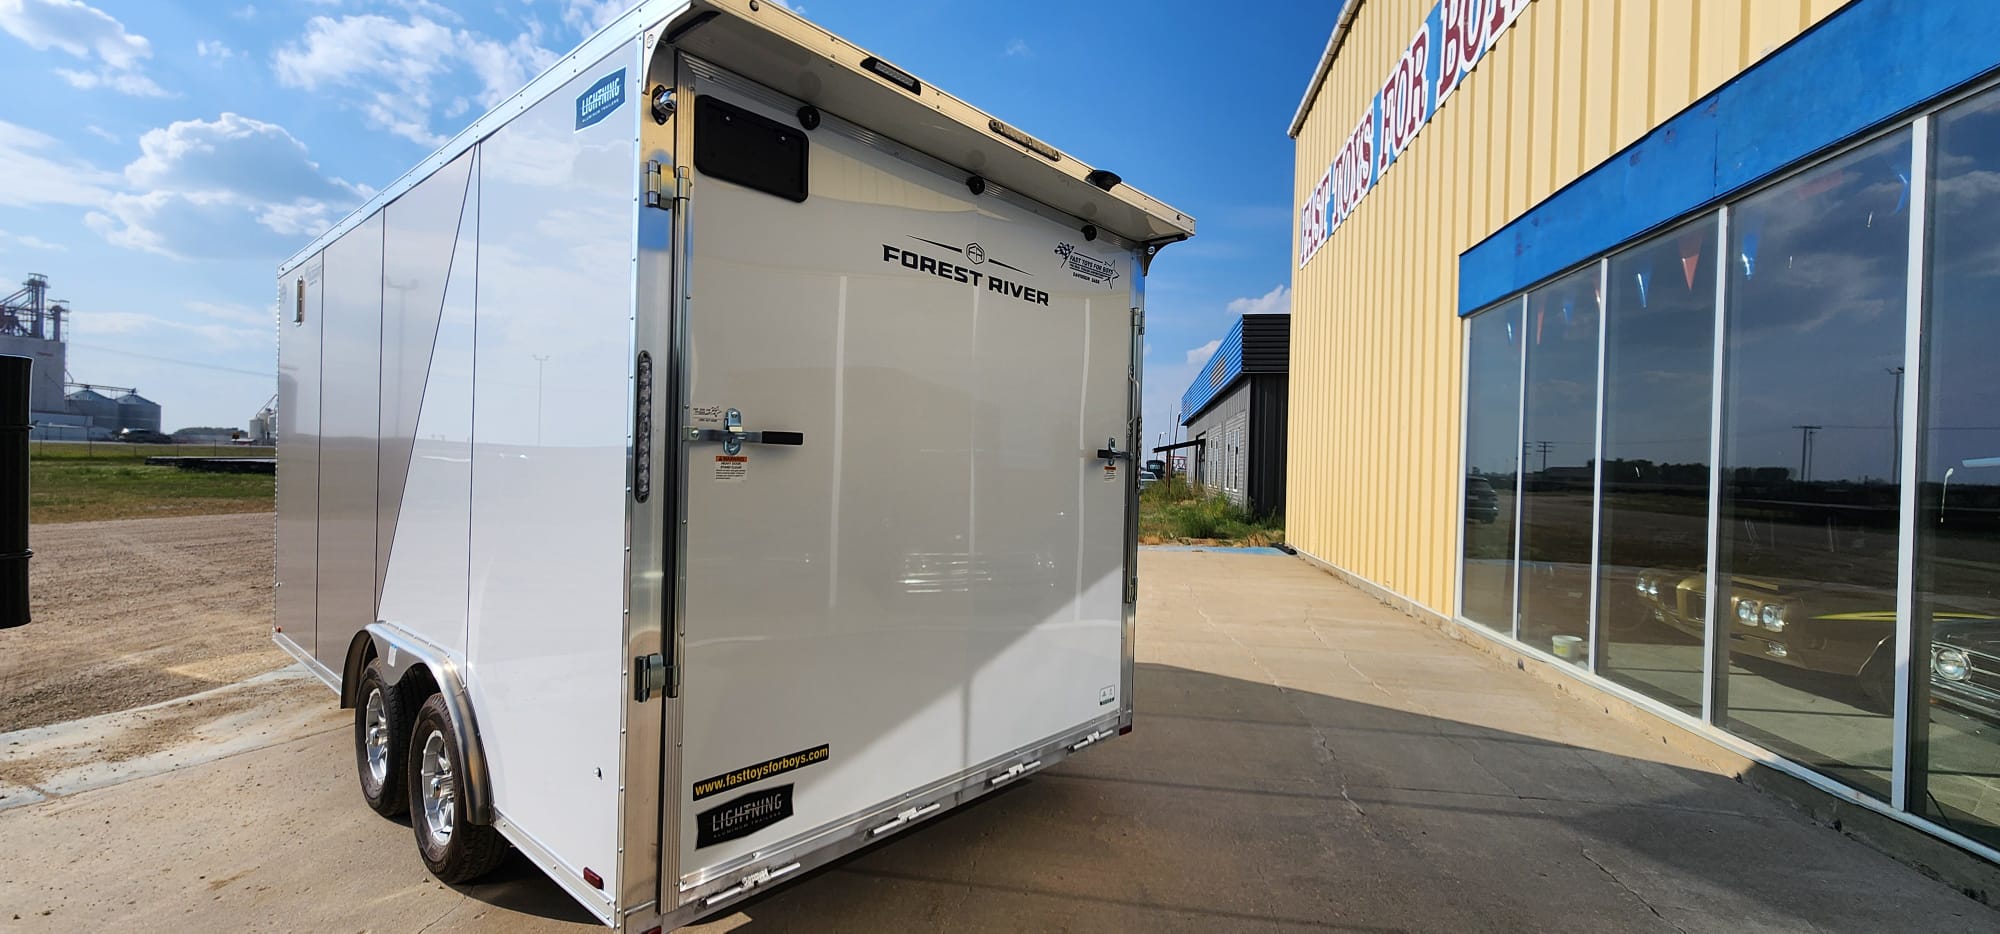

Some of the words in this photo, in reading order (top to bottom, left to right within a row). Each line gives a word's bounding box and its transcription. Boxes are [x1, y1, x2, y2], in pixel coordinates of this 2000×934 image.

[582, 78, 620, 116] LIGHTNING
[1301, 172, 1330, 266] FAST
[1333, 110, 1374, 227] TOYS
[1379, 27, 1428, 175] FOR
[882, 244, 983, 287] FOREST
[988, 275, 1049, 307] RIVER
[1070, 255, 1082, 264] FAST
[1082, 259, 1093, 268] TOYS
[1093, 263, 1103, 271] FOR
[1103, 266, 1114, 275] BOYS
[695, 747, 828, 796] www.fasttoysforboys.com
[712, 793, 782, 832] LIGHTNING
